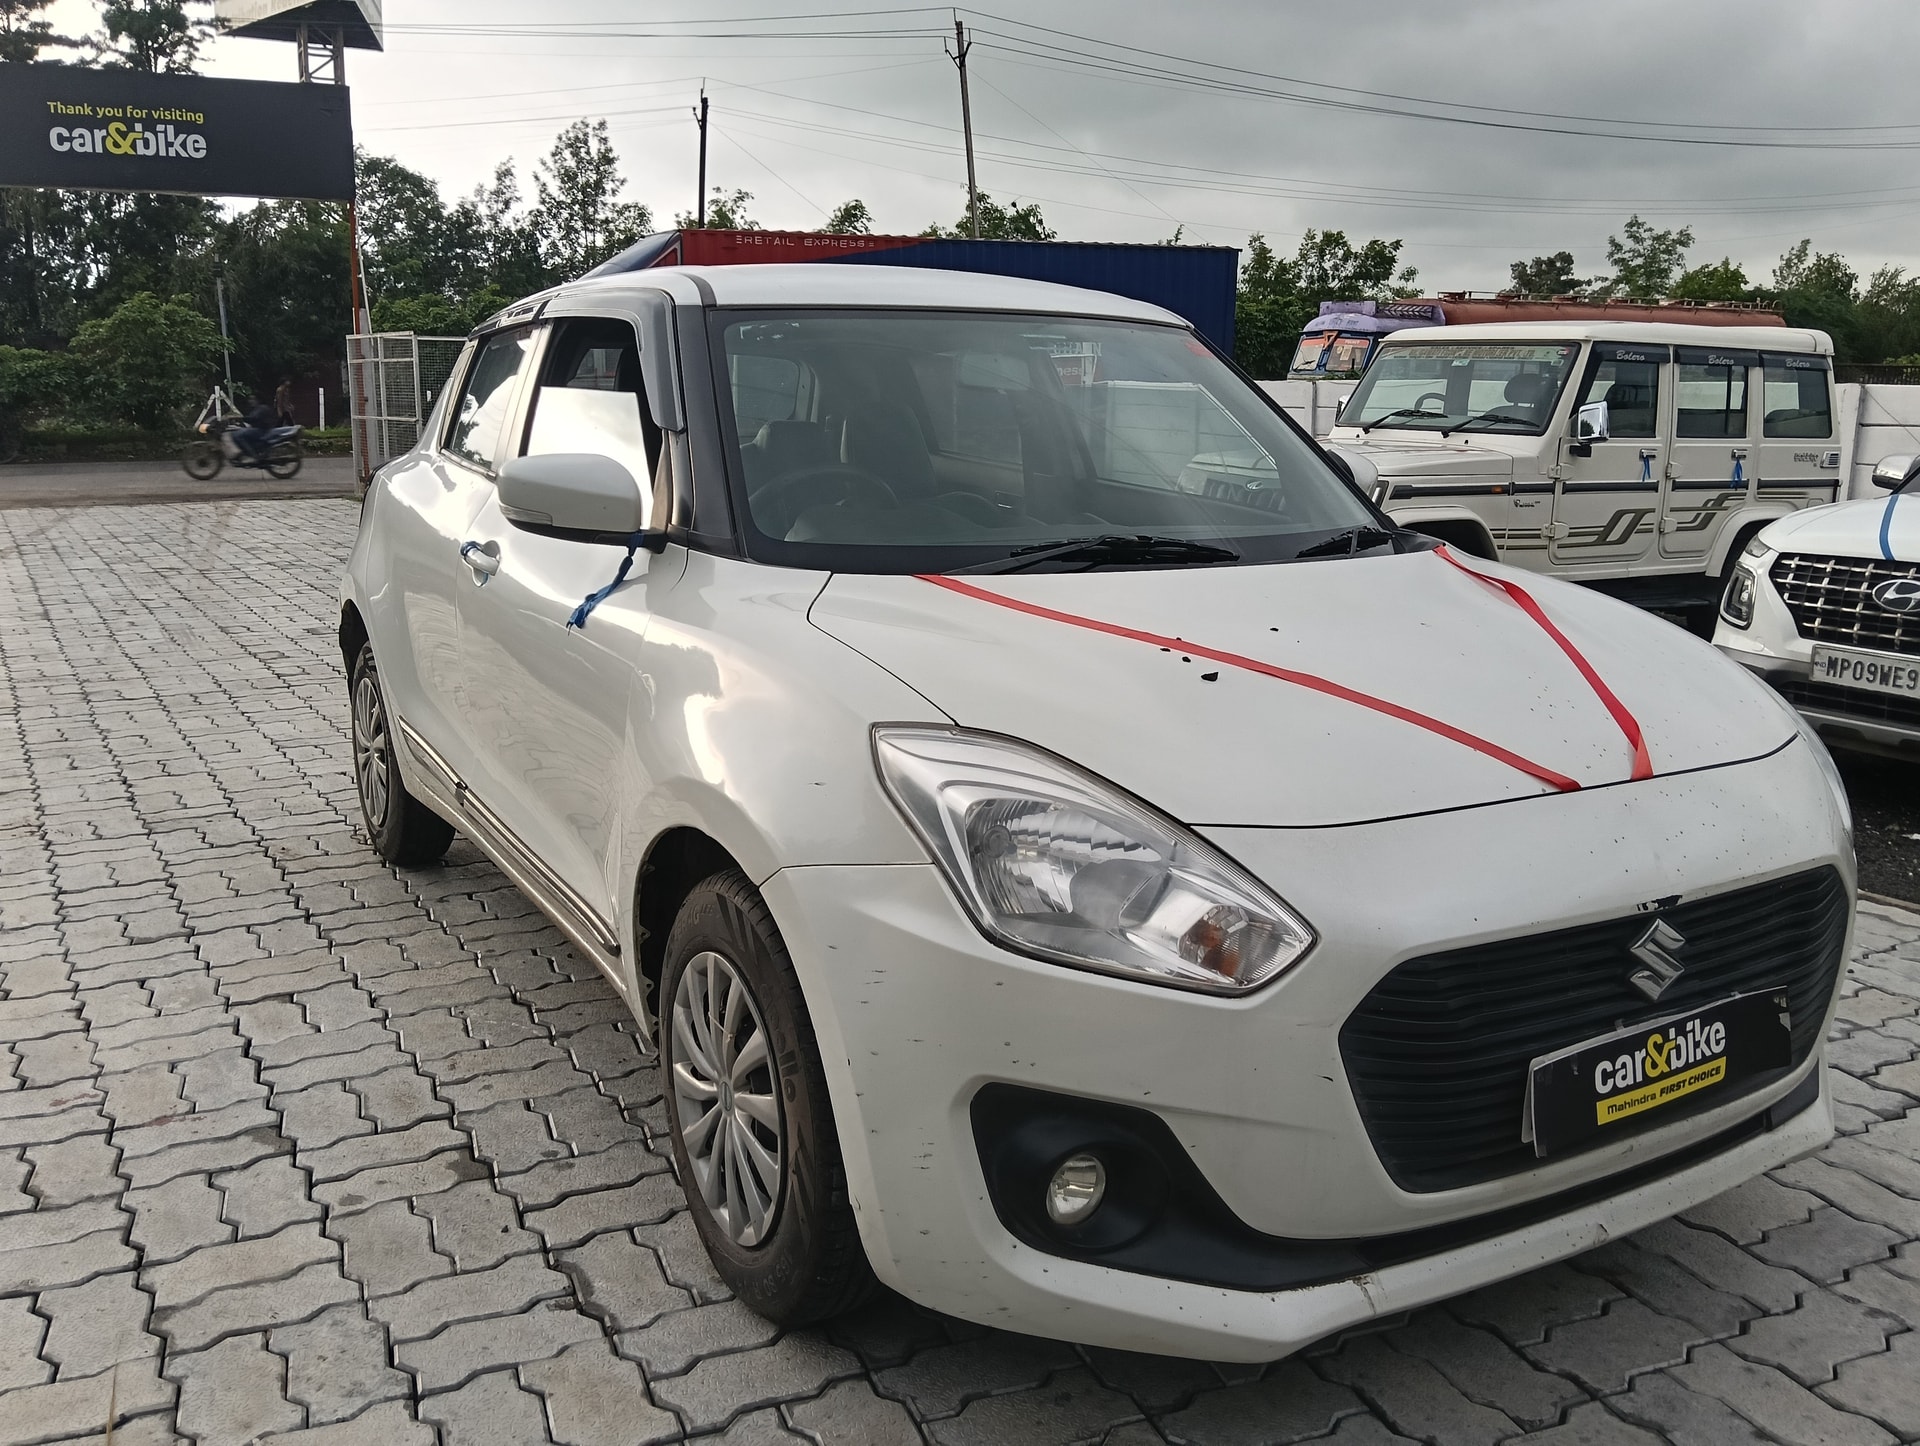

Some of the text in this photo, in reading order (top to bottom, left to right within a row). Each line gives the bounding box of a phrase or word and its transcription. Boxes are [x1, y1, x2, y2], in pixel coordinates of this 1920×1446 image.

[47, 101, 204, 124] Thank you for visiting
[49, 121, 207, 159] car&bike
[744, 235, 865, 248] RETAIL EXPRESS
[1616, 350, 1645, 361] Bolero
[1708, 354, 1735, 366] Bolero
[1785, 358, 1811, 368] Bolero
[1826, 655, 1919, 690] MP09WE9
[1594, 1018, 1726, 1094] car&bike
[1607, 1065, 1721, 1115] Mahindra FIRST CHOICE
